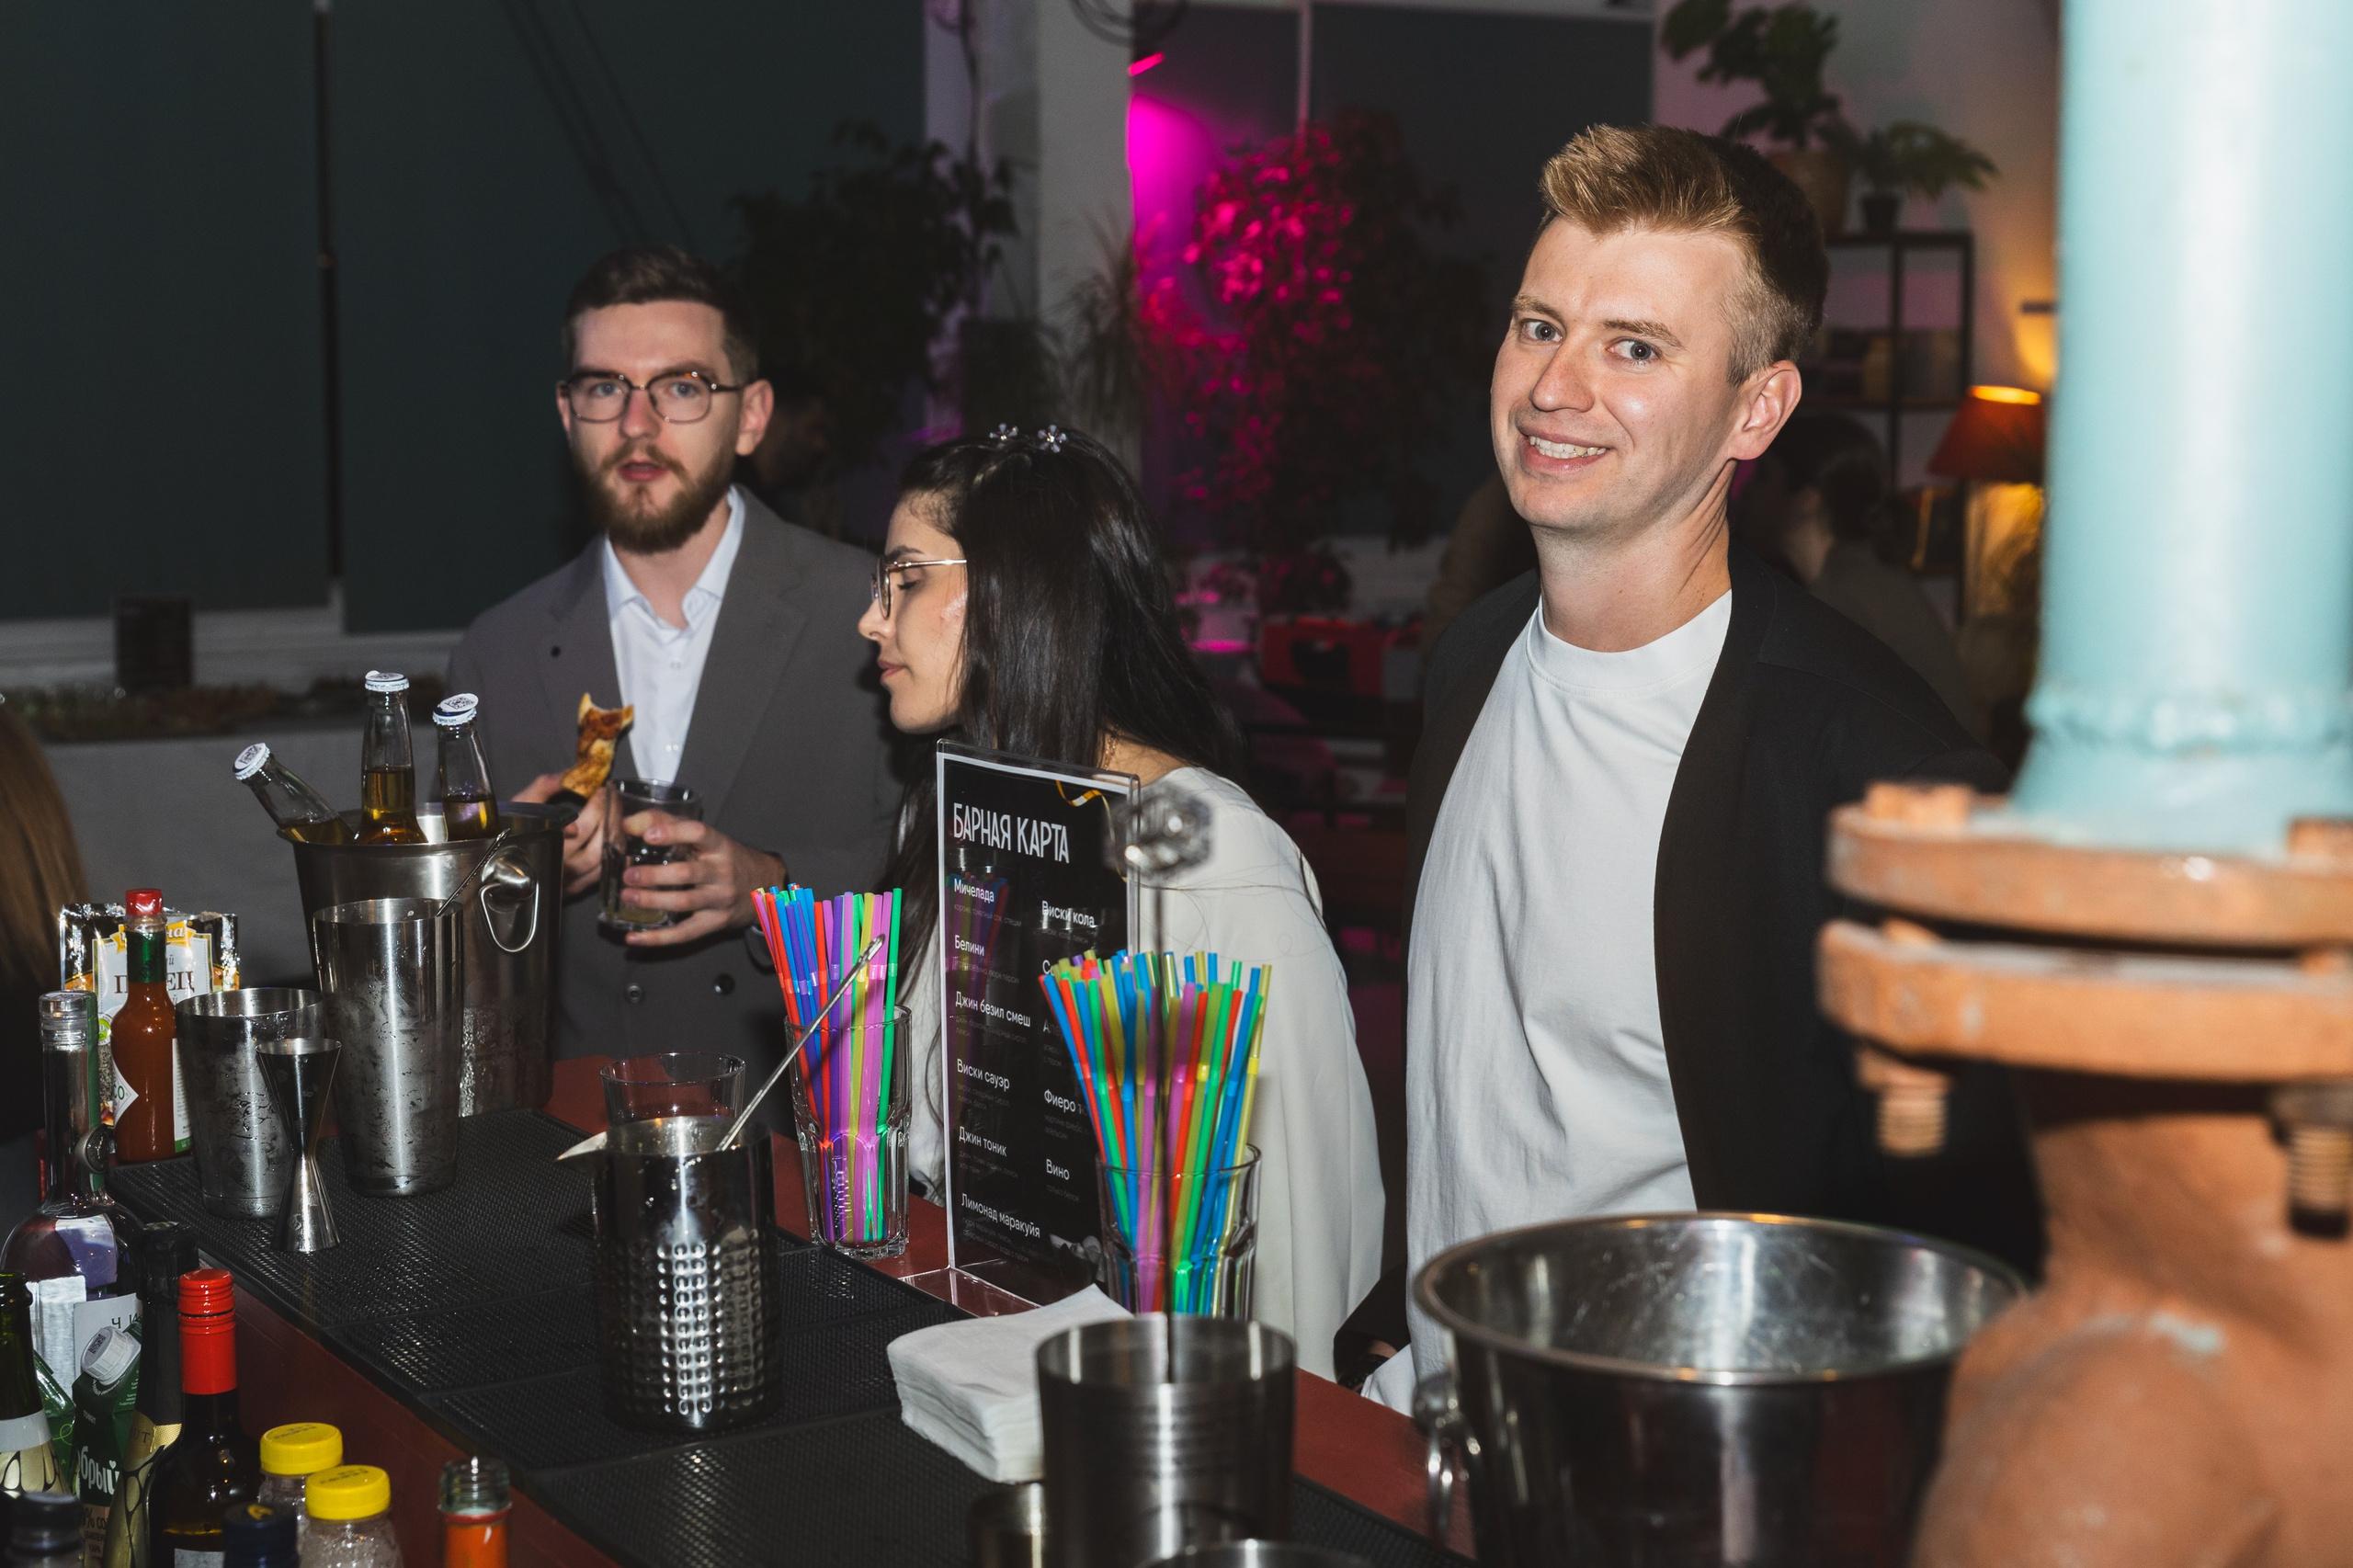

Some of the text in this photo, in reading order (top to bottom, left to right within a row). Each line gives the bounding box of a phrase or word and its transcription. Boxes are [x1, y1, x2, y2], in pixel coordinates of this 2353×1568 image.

[953, 802, 1070, 864] БАРНАЯ КАРТА
[954, 878, 995, 903] Мичелада
[1041, 900, 1095, 926] Виски кола
[954, 935, 984, 956] Белини
[955, 991, 978, 1011] Джин
[980, 998, 1004, 1019] безил
[1006, 1010, 1031, 1028] смеш
[957, 1058, 1010, 1092] Виски сауэр
[1044, 1088, 1076, 1113] Фиеро
[959, 1126, 1007, 1157] Джин тоник
[1046, 1158, 1070, 1181] Вино
[961, 1193, 998, 1223] Лимонад
[999, 1211, 1040, 1239] маракуйя
